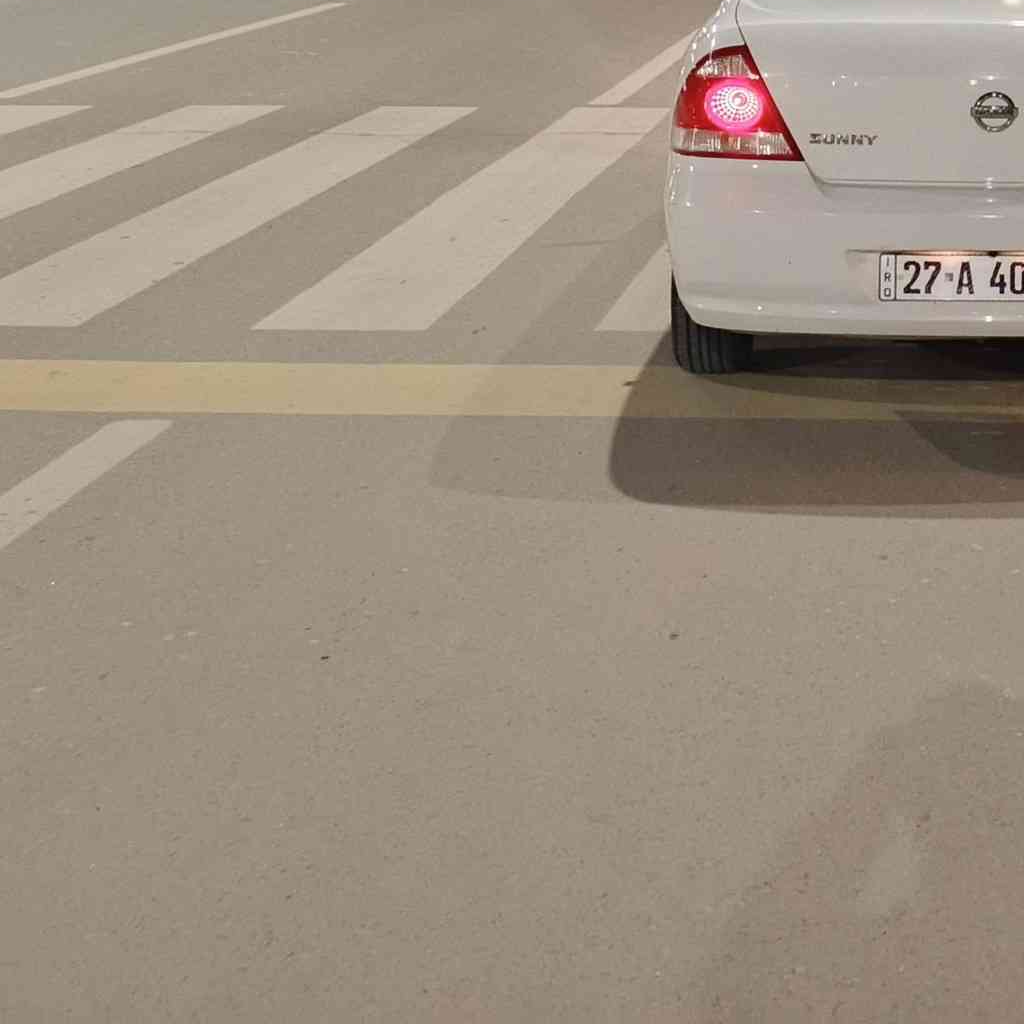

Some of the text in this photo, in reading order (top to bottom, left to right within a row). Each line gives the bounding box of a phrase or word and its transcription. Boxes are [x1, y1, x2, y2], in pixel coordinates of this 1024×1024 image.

[809, 132, 878, 146] SUNNY
[903, 260, 942, 295] 27
[956, 261, 975, 295] A
